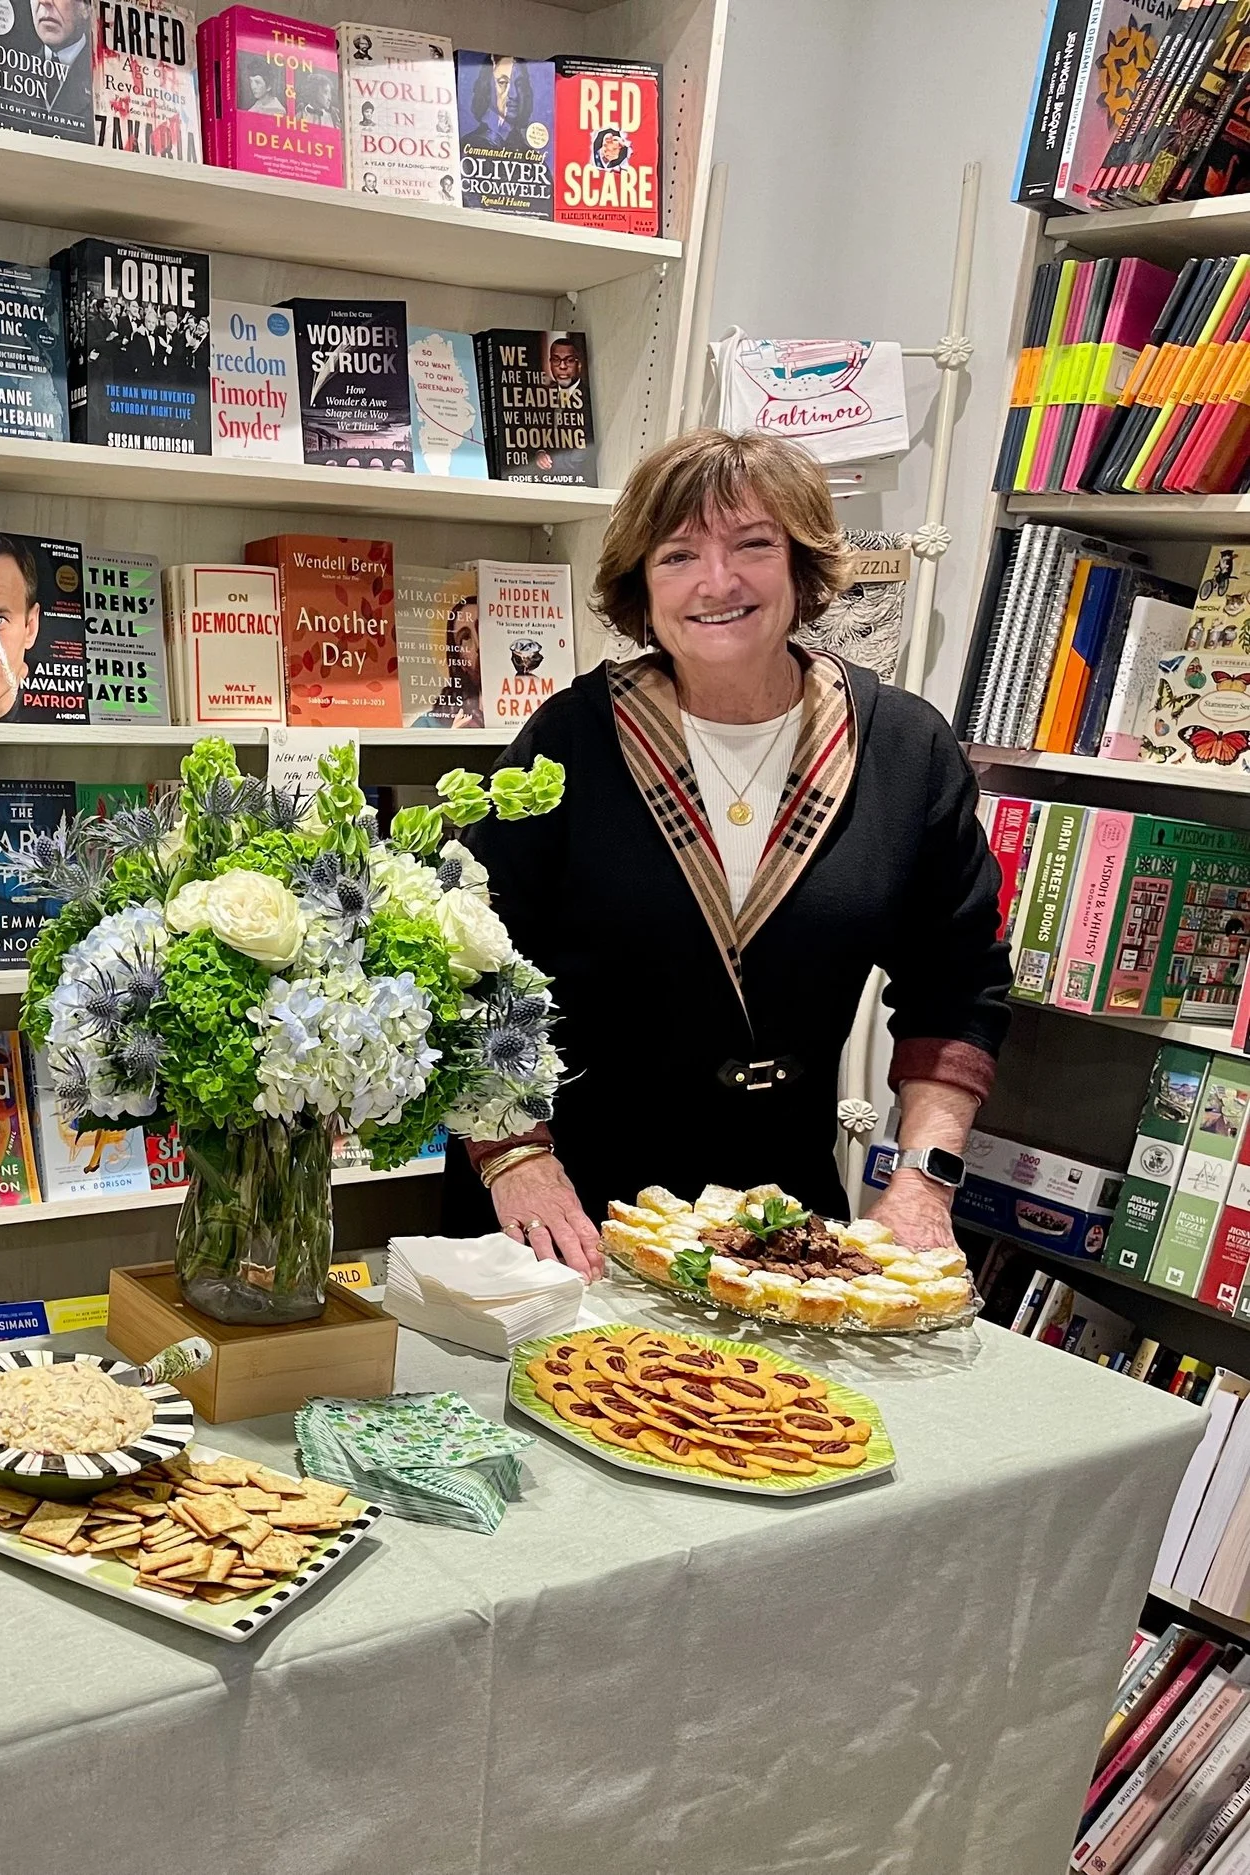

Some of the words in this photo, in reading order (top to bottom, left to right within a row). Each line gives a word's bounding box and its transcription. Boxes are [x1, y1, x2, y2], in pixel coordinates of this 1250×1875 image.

[353, 78, 451, 104] WORLD
[0, 103, 26, 115] LIGHT
[30, 110, 85, 129] WITHDRAWN
[580, 79, 642, 132] RED
[248, 131, 334, 159] IDEALIST
[463, 144, 511, 159] Commander
[514, 149, 522, 159] in
[525, 150, 548, 164] Chief
[395, 187, 420, 197] DAVIS
[564, 162, 653, 208] SCARE
[104, 256, 195, 308] LORNE
[230, 314, 256, 341] On
[414, 360, 430, 368] YOU
[431, 362, 451, 370] WANT
[500, 346, 527, 367] WE
[346, 385, 365, 395] How
[502, 387, 583, 408] LEADERS
[761, 404, 869, 427] baltimore
[218, 411, 280, 448] Snyder
[499, 588, 550, 602] HIDDEN
[489, 604, 563, 619] POTENTIAL
[1196, 604, 1220, 612] MEOW
[296, 607, 388, 637] Another
[322, 642, 366, 674] Day
[418, 643, 470, 653] HISTORICAL
[21, 677, 84, 693] NAVALNY
[24, 694, 84, 709] PATRIOT
[208, 695, 272, 705] WHITMAN
[1008, 808, 1023, 831] BOOK
[1000, 831, 1021, 854] TOWN
[1060, 816, 1074, 851] MAIN
[1048, 854, 1067, 900] STREET
[1099, 855, 1115, 899] WISDOM
[1083, 883, 1096, 927] BOOKSHOP
[1098, 900, 1107, 909] &
[1038, 903, 1057, 943] BOOKS
[1085, 911, 1102, 957] WHIMSY
[71, 1184, 85, 1192] B.K.
[94, 1179, 132, 1189] BORISON
[1128, 1202, 1157, 1216] PUZZLE
[1130, 1195, 1159, 1207] JIGSAW
[1161, 1681, 1184, 1706] better
[1148, 1705, 1163, 1724] than
[1134, 1723, 1149, 1742] new
[1162, 1718, 1189, 1749] Japanese
[1140, 1748, 1164, 1779] Knitting
[1118, 1778, 1142, 1805] Stitches
